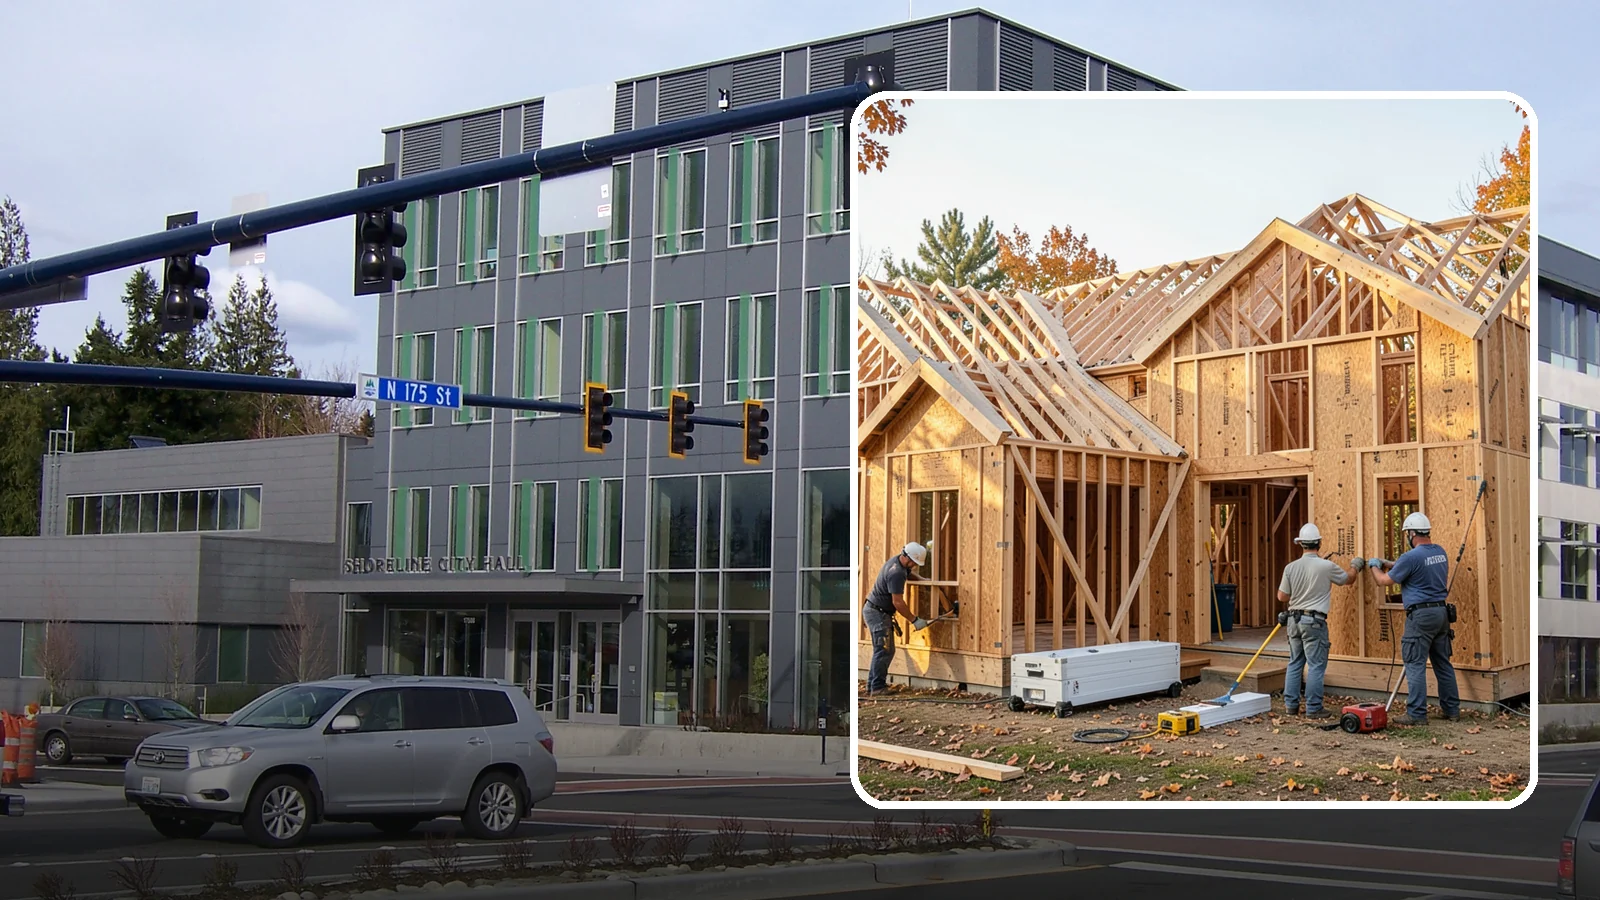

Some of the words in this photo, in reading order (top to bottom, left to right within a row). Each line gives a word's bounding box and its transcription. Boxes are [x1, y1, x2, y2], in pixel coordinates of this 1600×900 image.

[387, 380, 396, 399] N
[405, 382, 427, 403] 175
[435, 386, 451, 406] St
[344, 556, 432, 574] SHORELINE
[438, 556, 475, 572] CITY
[484, 555, 525, 571] HALL
